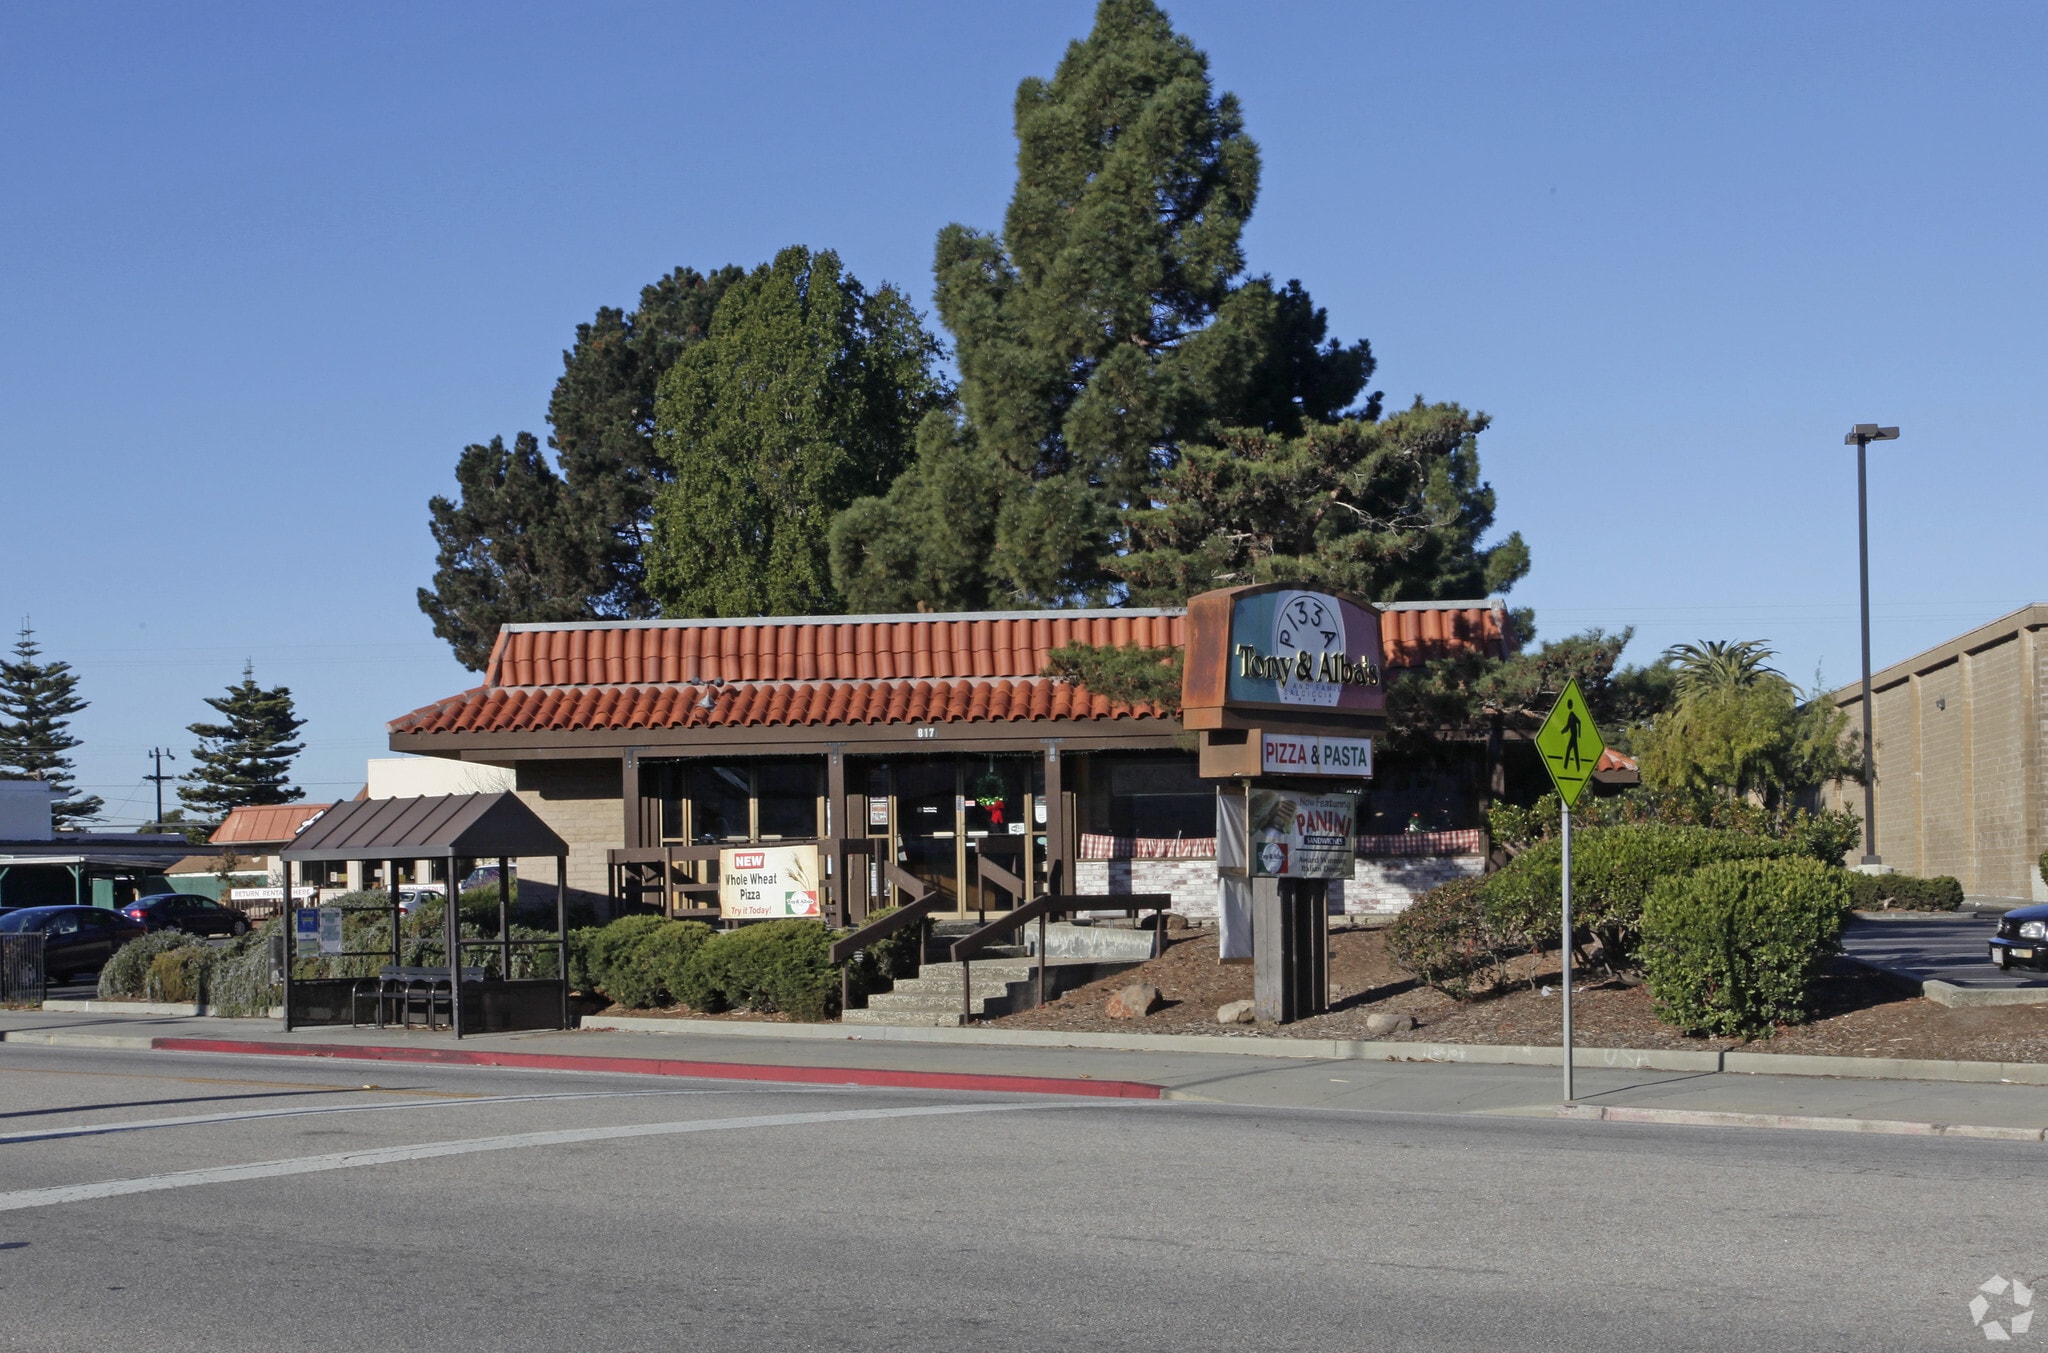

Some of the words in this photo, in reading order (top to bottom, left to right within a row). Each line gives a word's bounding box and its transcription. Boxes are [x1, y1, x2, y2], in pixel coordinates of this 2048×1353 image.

[1235, 644, 1293, 688] Tony
[1295, 649, 1314, 682] &
[1316, 651, 1380, 687] Alba's
[917, 727, 935, 738] 817
[1265, 742, 1307, 765] PIZZA
[1311, 744, 1320, 766] &
[1324, 744, 1368, 768] PASTA
[1300, 796, 1314, 807] Now
[1296, 810, 1352, 838] PANINI
[1306, 837, 1343, 845] SANDWICHES
[735, 856, 762, 866] NEW
[750, 873, 777, 885] Wheat
[740, 889, 761, 900] Pizza
[731, 907, 741, 916] Try
[743, 906, 748, 914] it
[749, 906, 771, 915] Today!
